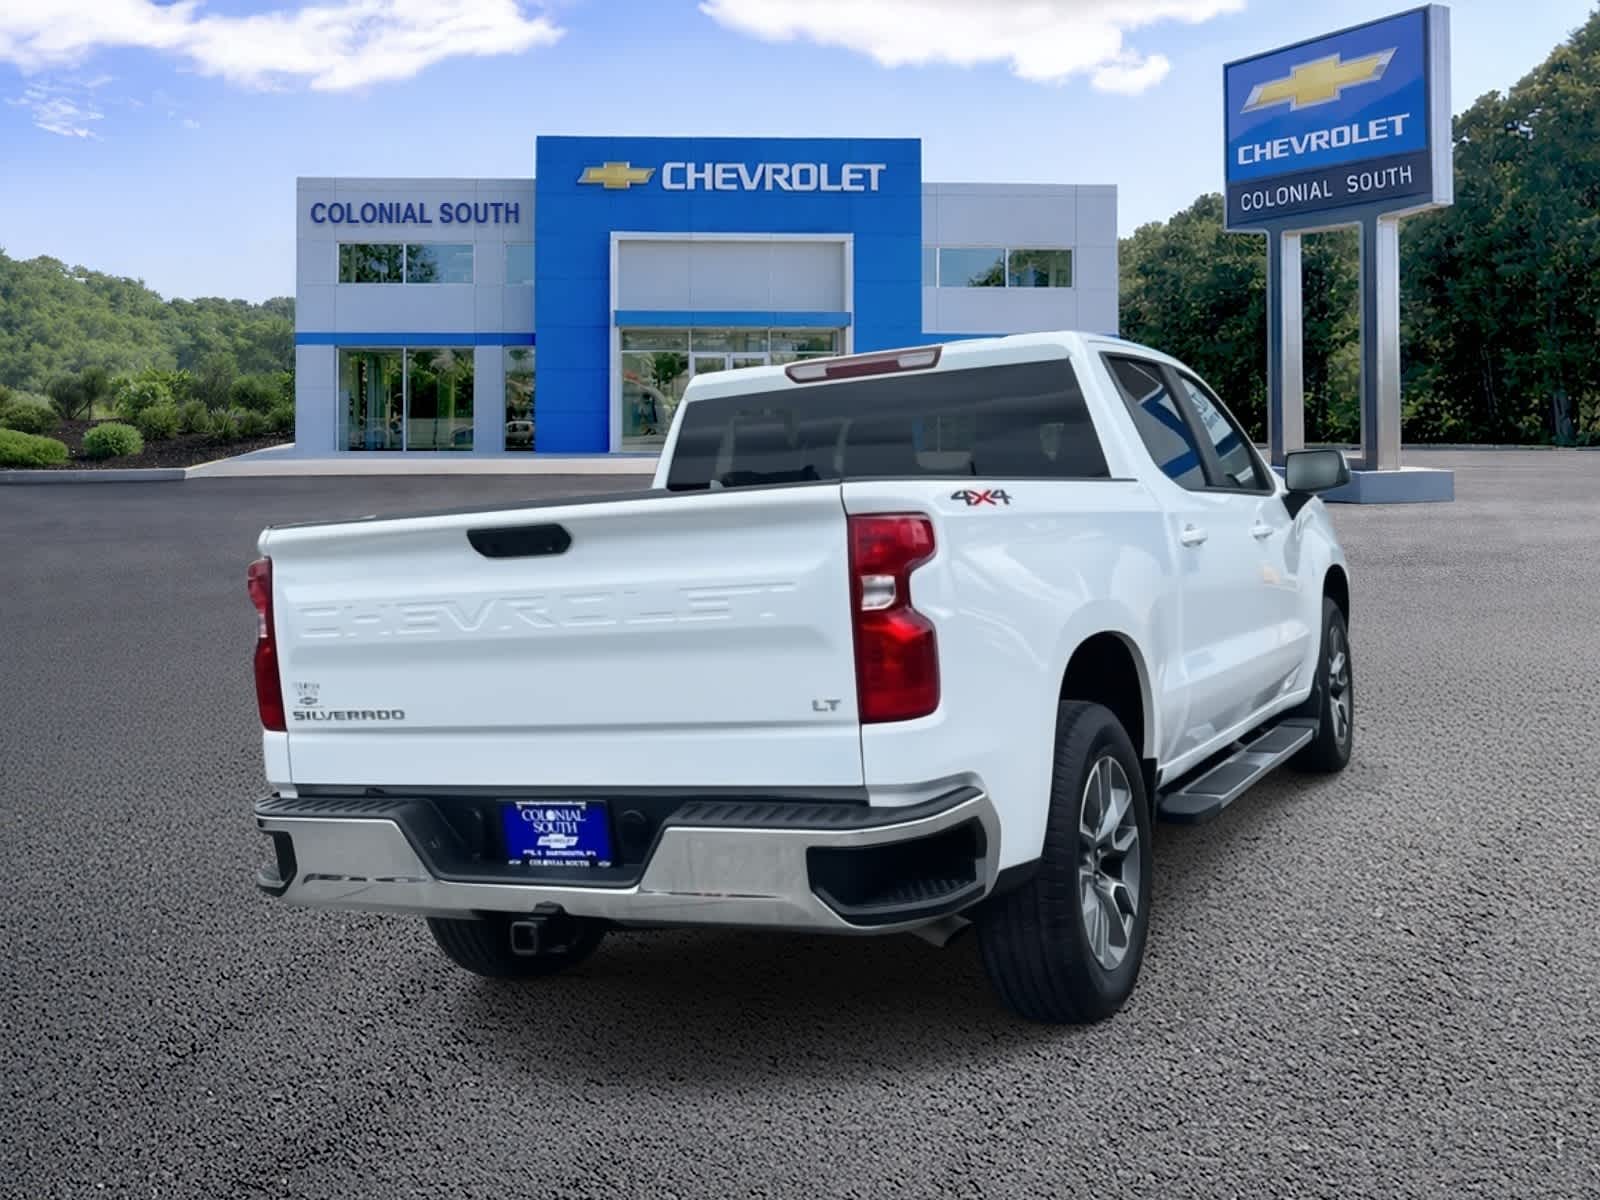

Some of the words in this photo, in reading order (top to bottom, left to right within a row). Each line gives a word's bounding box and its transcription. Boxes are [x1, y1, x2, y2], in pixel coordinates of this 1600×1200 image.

[1237, 113, 1411, 165] CHEVROLET
[662, 162, 887, 192] CHEVROLET
[1241, 180, 1333, 212] COLONIAL
[1347, 165, 1413, 193] SOUTH
[310, 202, 433, 225] COLONIAL
[439, 202, 521, 225] SOUTH
[812, 699, 841, 711] LT
[293, 710, 406, 721] SILVERADO
[521, 809, 586, 821] COLONIAL
[532, 821, 578, 833] SOUTH
